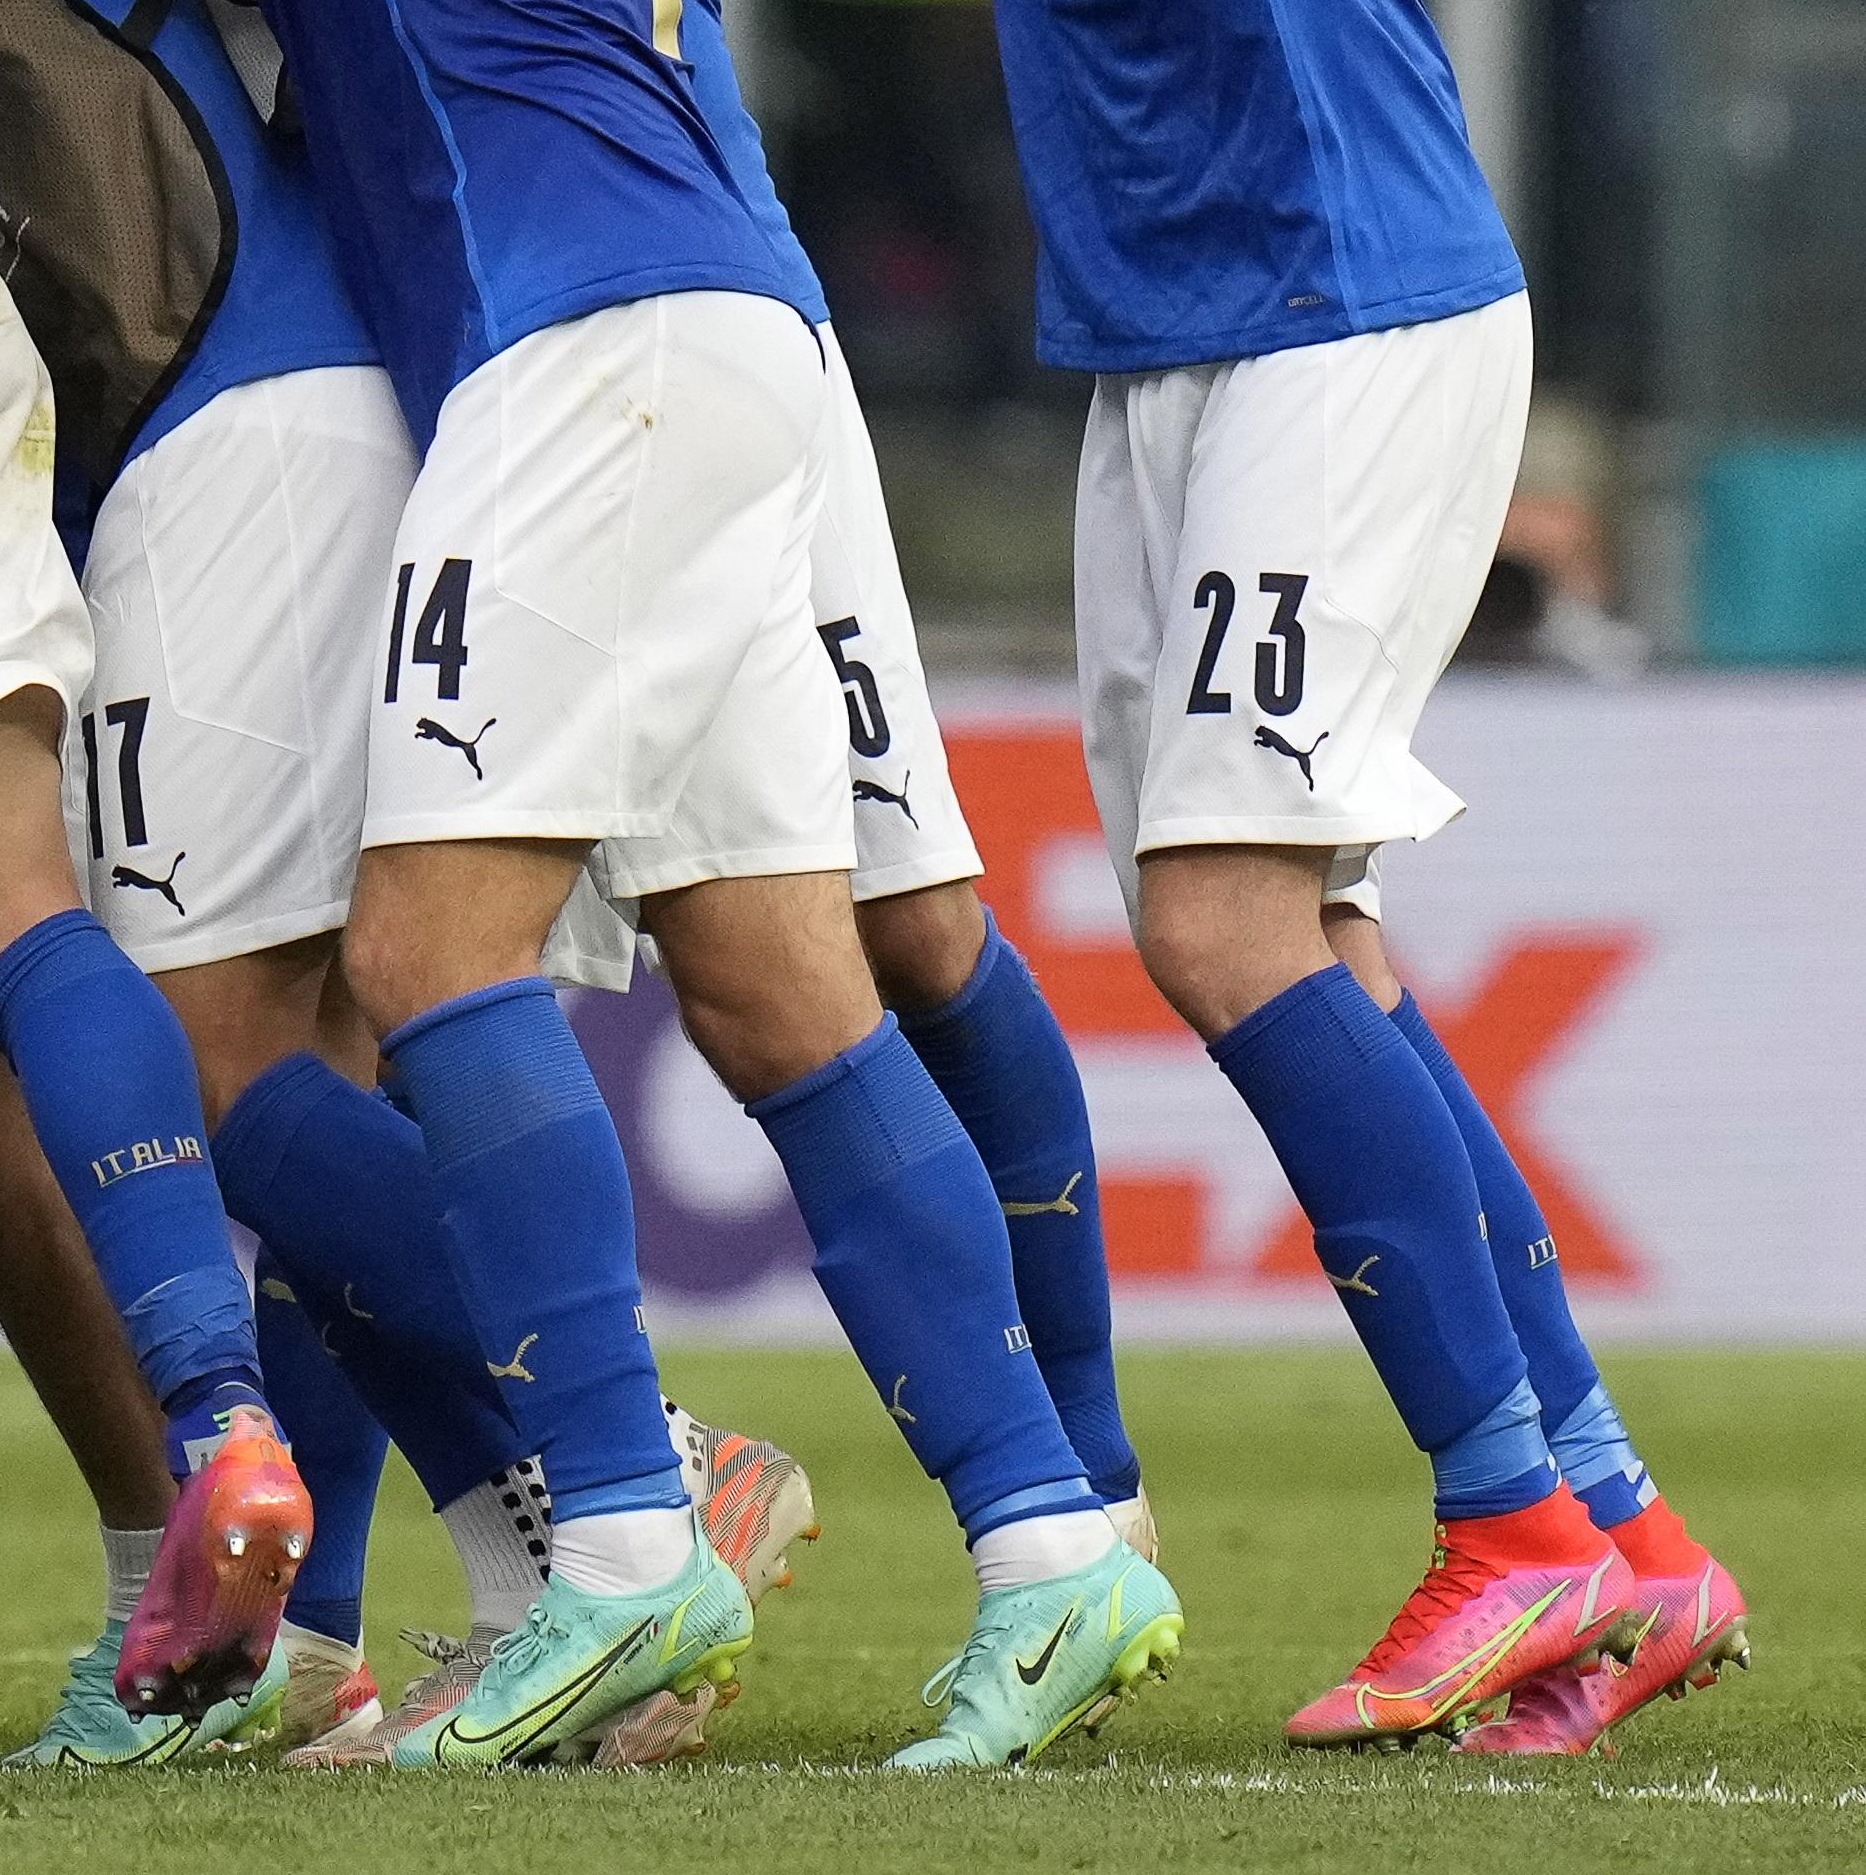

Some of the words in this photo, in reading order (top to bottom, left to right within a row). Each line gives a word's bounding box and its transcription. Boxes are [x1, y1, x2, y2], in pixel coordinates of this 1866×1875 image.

[384, 557, 472, 704] 14
[1186, 569, 1310, 717] 23
[80, 696, 151, 860] 17
[92, 1136, 203, 1185] ITALIA
